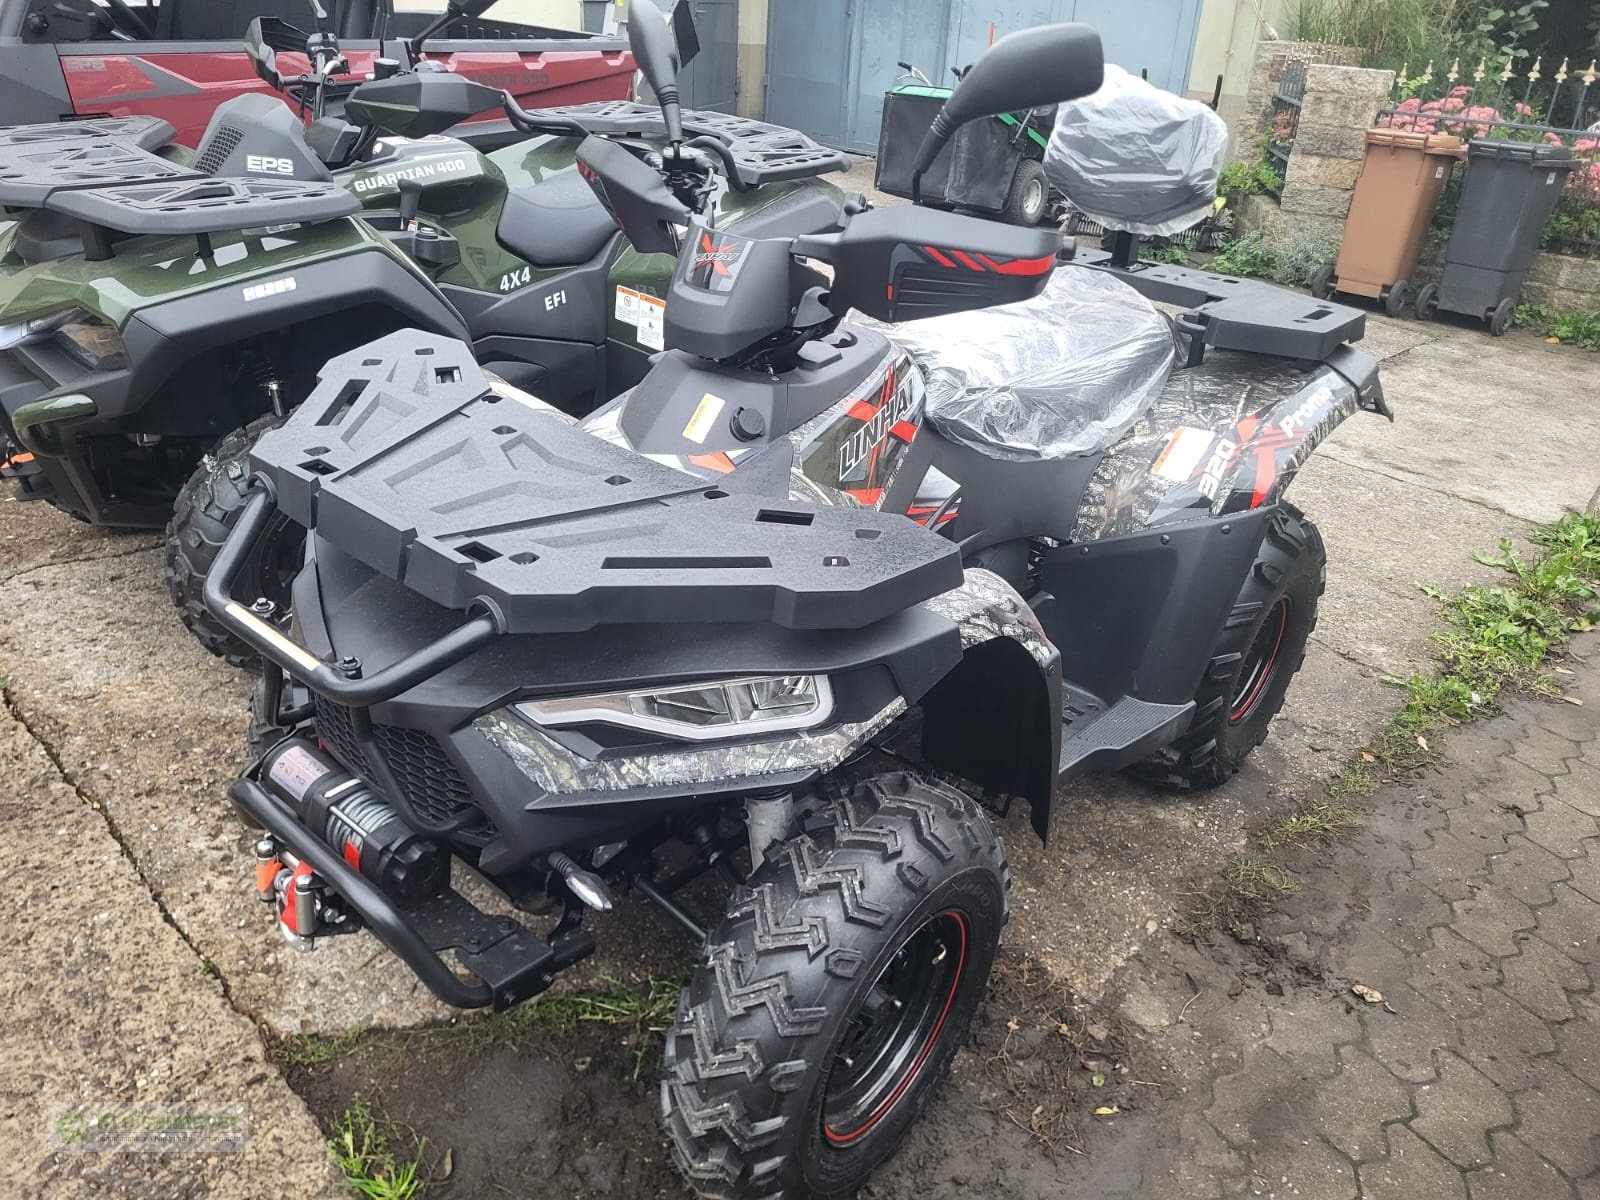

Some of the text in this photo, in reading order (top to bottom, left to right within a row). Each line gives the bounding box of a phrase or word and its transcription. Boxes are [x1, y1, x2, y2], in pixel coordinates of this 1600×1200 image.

[247, 155, 294, 173] EPS
[354, 159, 466, 192] GUARDIAN 400
[544, 289, 567, 311] EFI
[839, 373, 915, 482] LINHAI
[1198, 438, 1236, 501] 320
